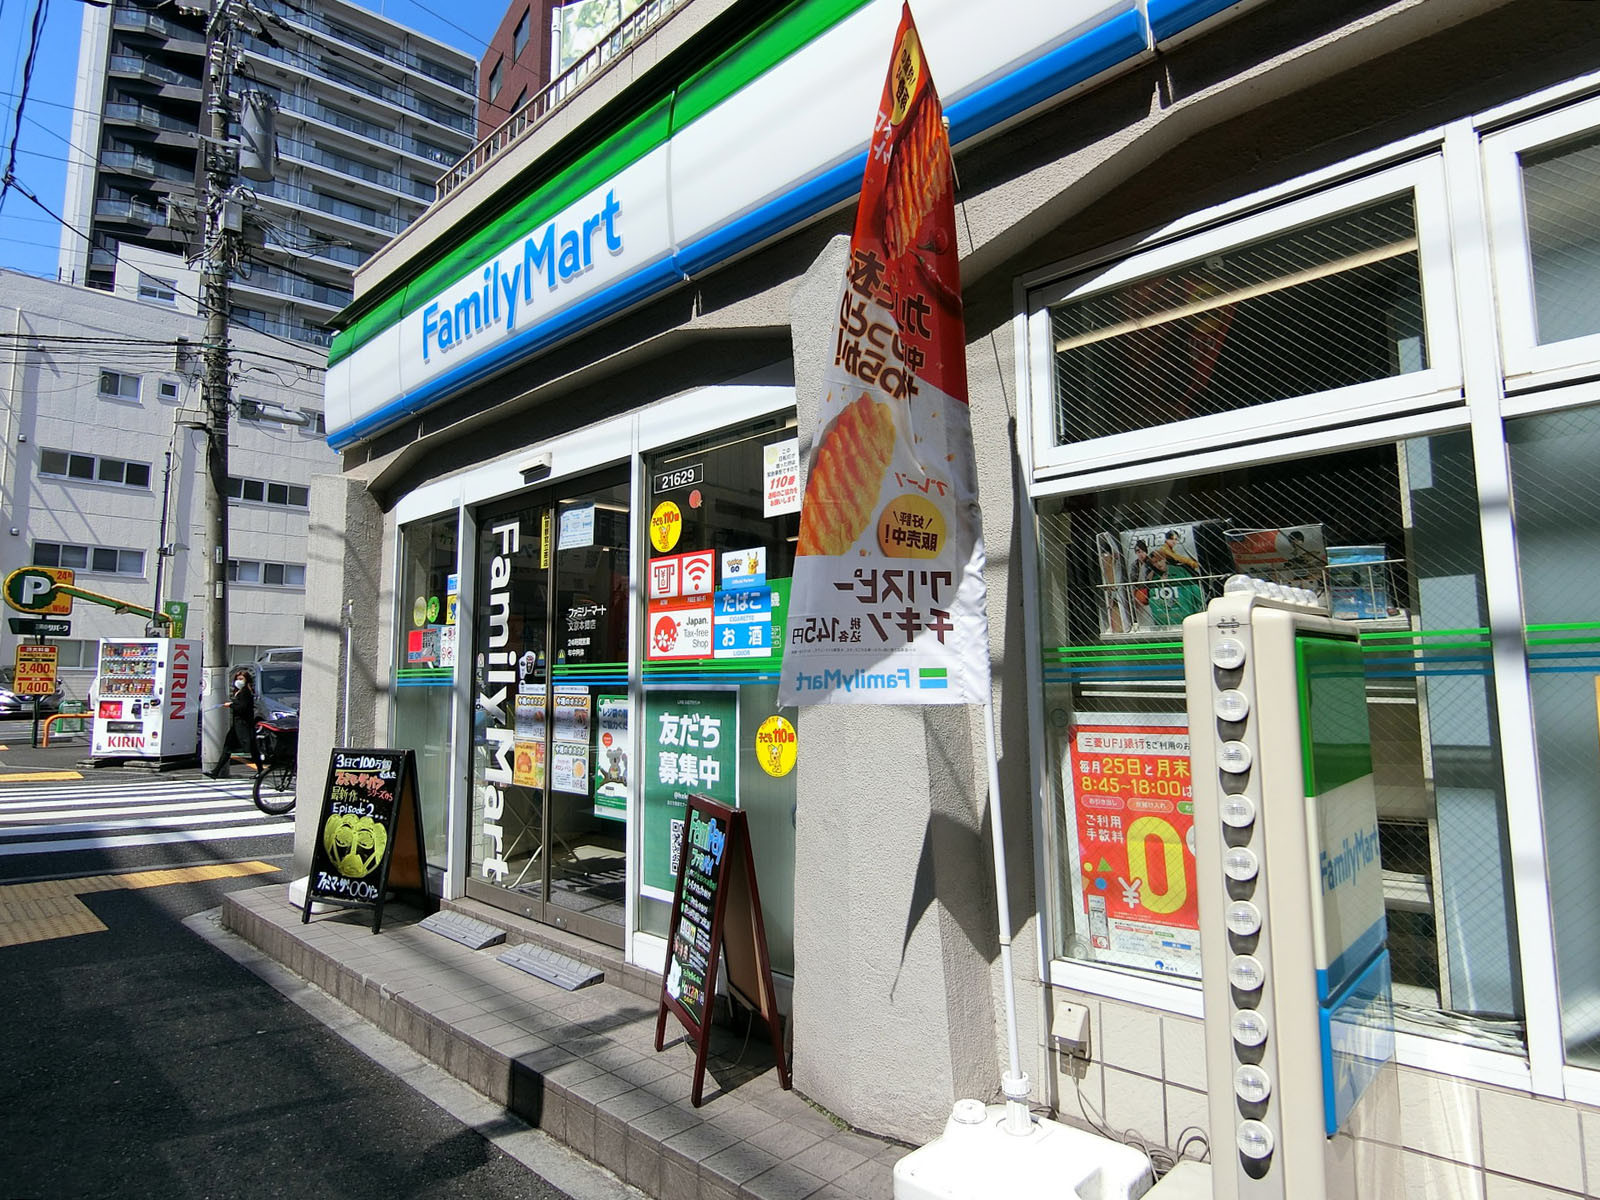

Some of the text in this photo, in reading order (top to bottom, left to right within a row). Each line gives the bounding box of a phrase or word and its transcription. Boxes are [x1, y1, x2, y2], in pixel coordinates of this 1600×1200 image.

[423, 188, 622, 361] FamilyMart
[662, 469, 695, 489] 21629
[770, 475, 796, 489] 110番
[22, 575, 52, 605] P
[568, 604, 607, 618] ファミリーマート
[722, 591, 762, 613] たばこ
[683, 629, 709, 638] Tax-free
[722, 625, 763, 646] お酒
[692, 639, 709, 649] Shop
[170, 644, 190, 720] KIRIN
[482, 521, 520, 882] FamilyMart
[658, 712, 721, 749] 友だち
[759, 728, 795, 744] 子ども110番
[108, 736, 145, 748] KIRIN
[336, 753, 393, 770] 3日で100万個
[658, 751, 720, 789] 募集中
[1079, 757, 1191, 778] 毎月25日と月末
[332, 802, 366, 815] Episode
[1085, 814, 1122, 829] ご利用
[1085, 828, 1124, 844] 手数料
[1320, 824, 1379, 897] FamilyMart
